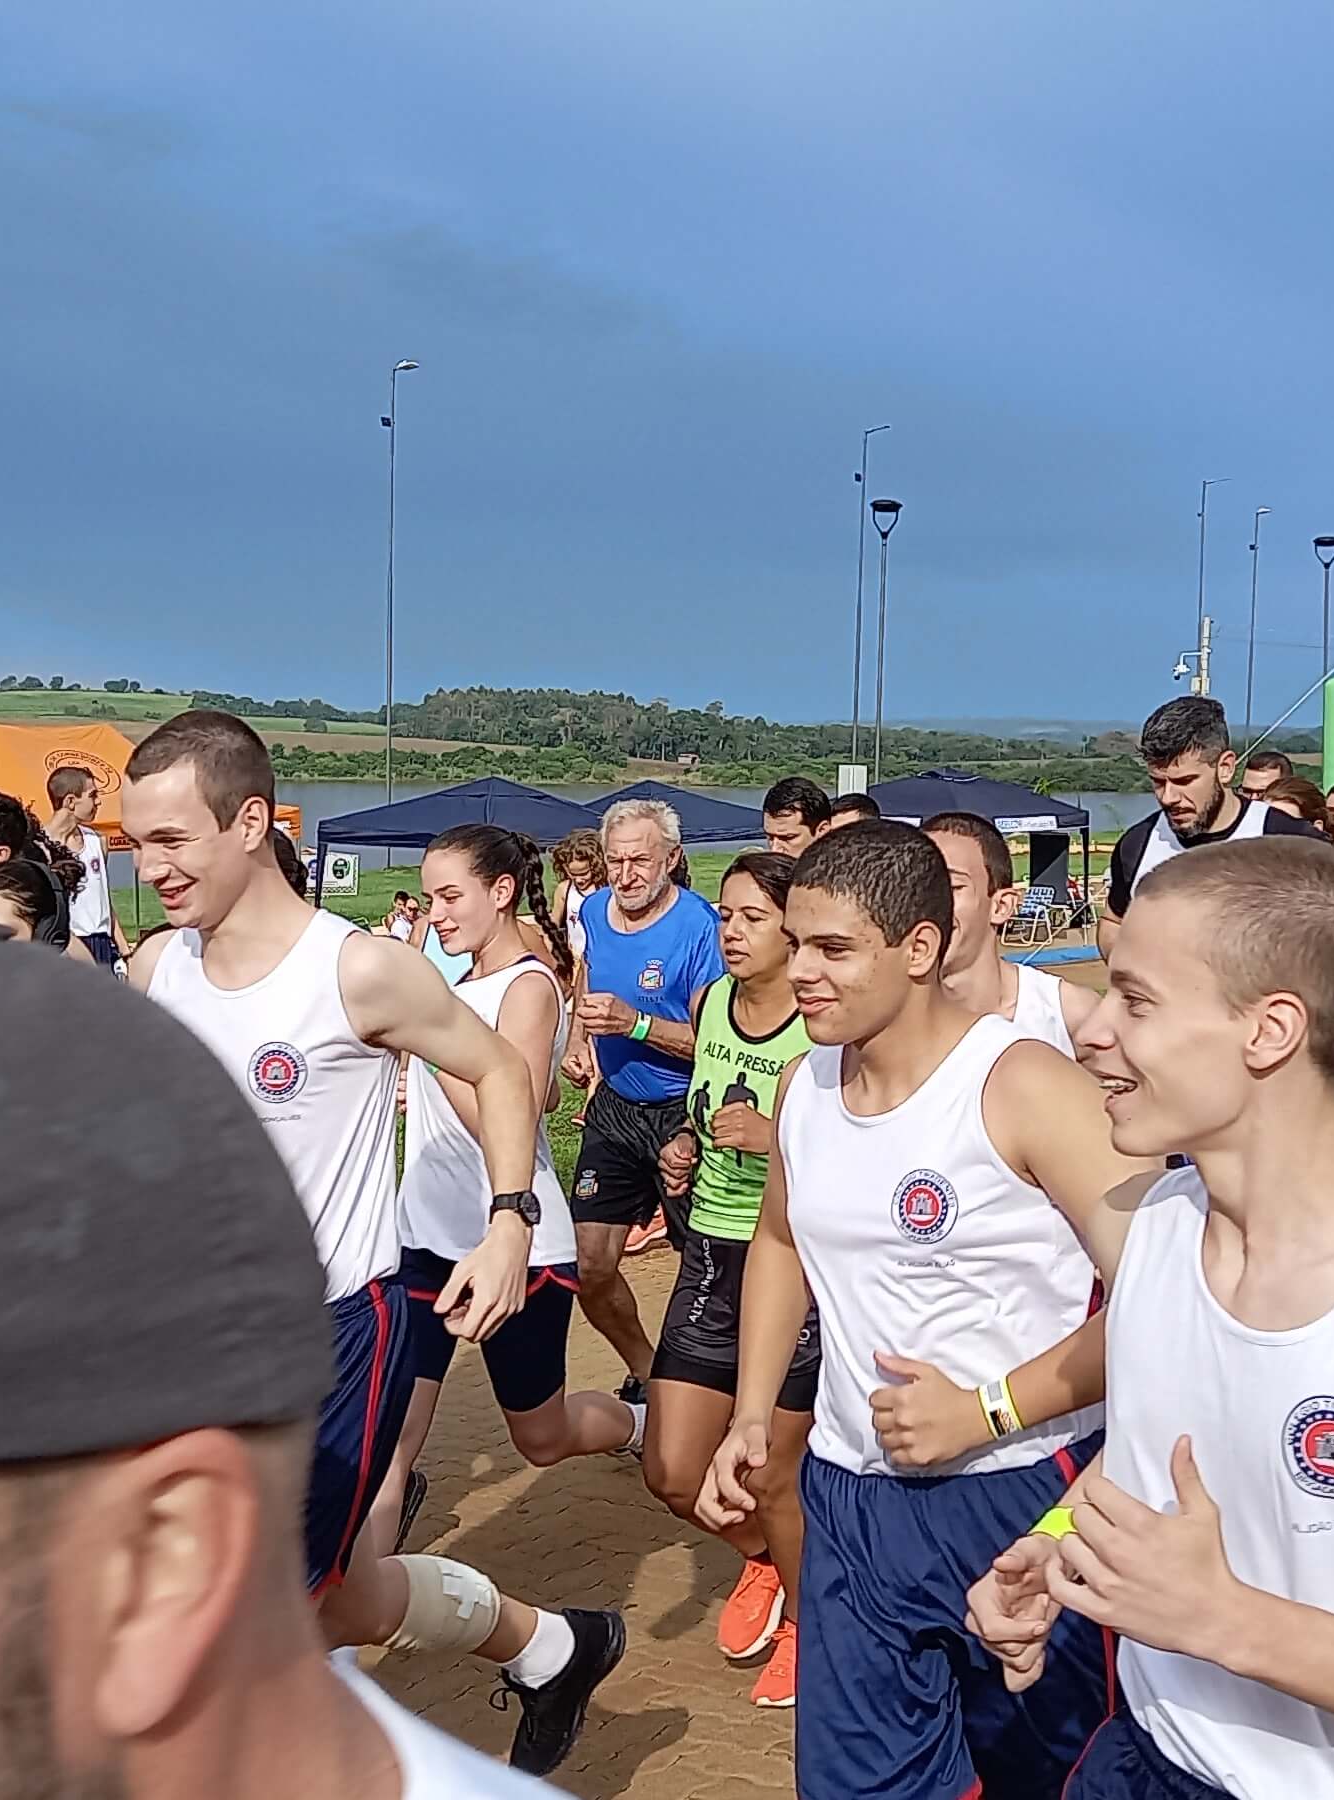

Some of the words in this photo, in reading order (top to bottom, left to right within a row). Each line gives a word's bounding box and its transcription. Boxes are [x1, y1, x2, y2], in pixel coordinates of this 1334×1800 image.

[703, 1040, 731, 1063] ALTA
[735, 1051, 786, 1077] PRESSÃ
[688, 1295, 710, 1323] ALTA
